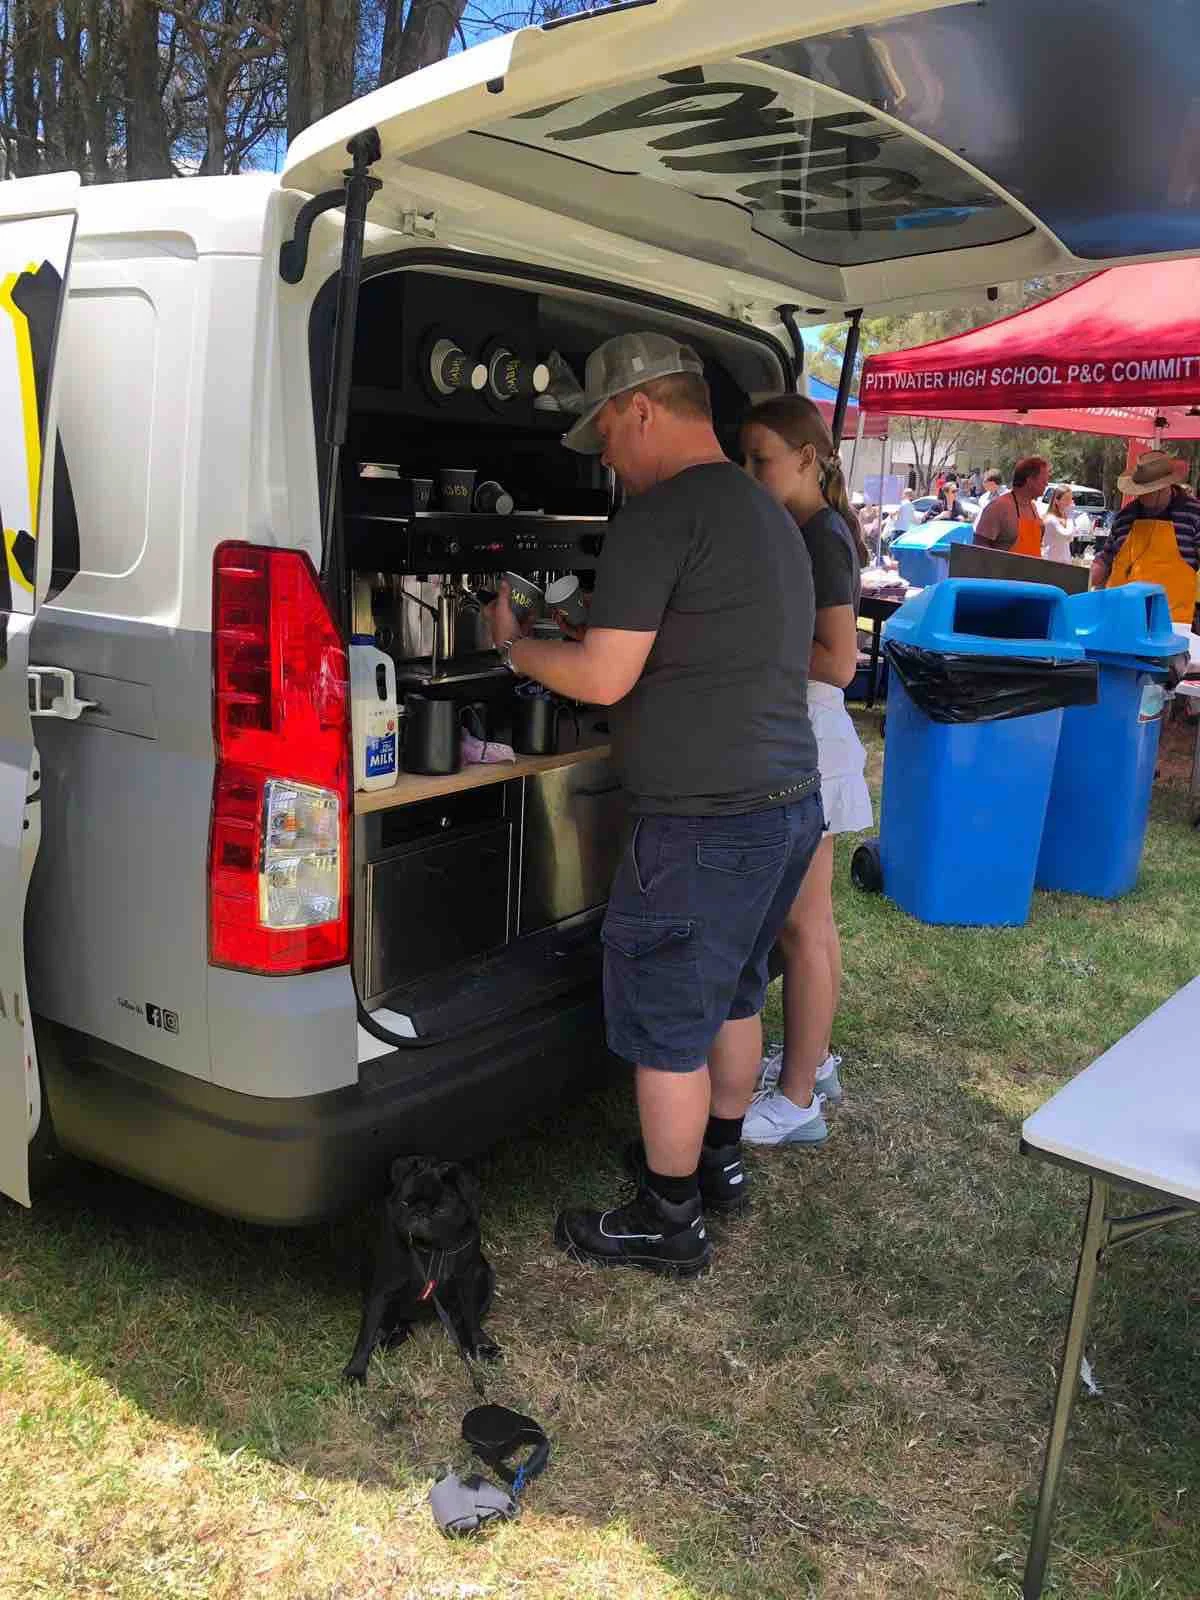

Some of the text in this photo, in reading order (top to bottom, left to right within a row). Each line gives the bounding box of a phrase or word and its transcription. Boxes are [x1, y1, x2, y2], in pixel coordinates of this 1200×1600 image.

[865, 372, 944, 390] PITTWATER
[948, 369, 986, 388] HIGH
[990, 365, 1062, 386] SCHOOL
[1067, 363, 1105, 384] P&C
[370, 753, 394, 769] MILK
